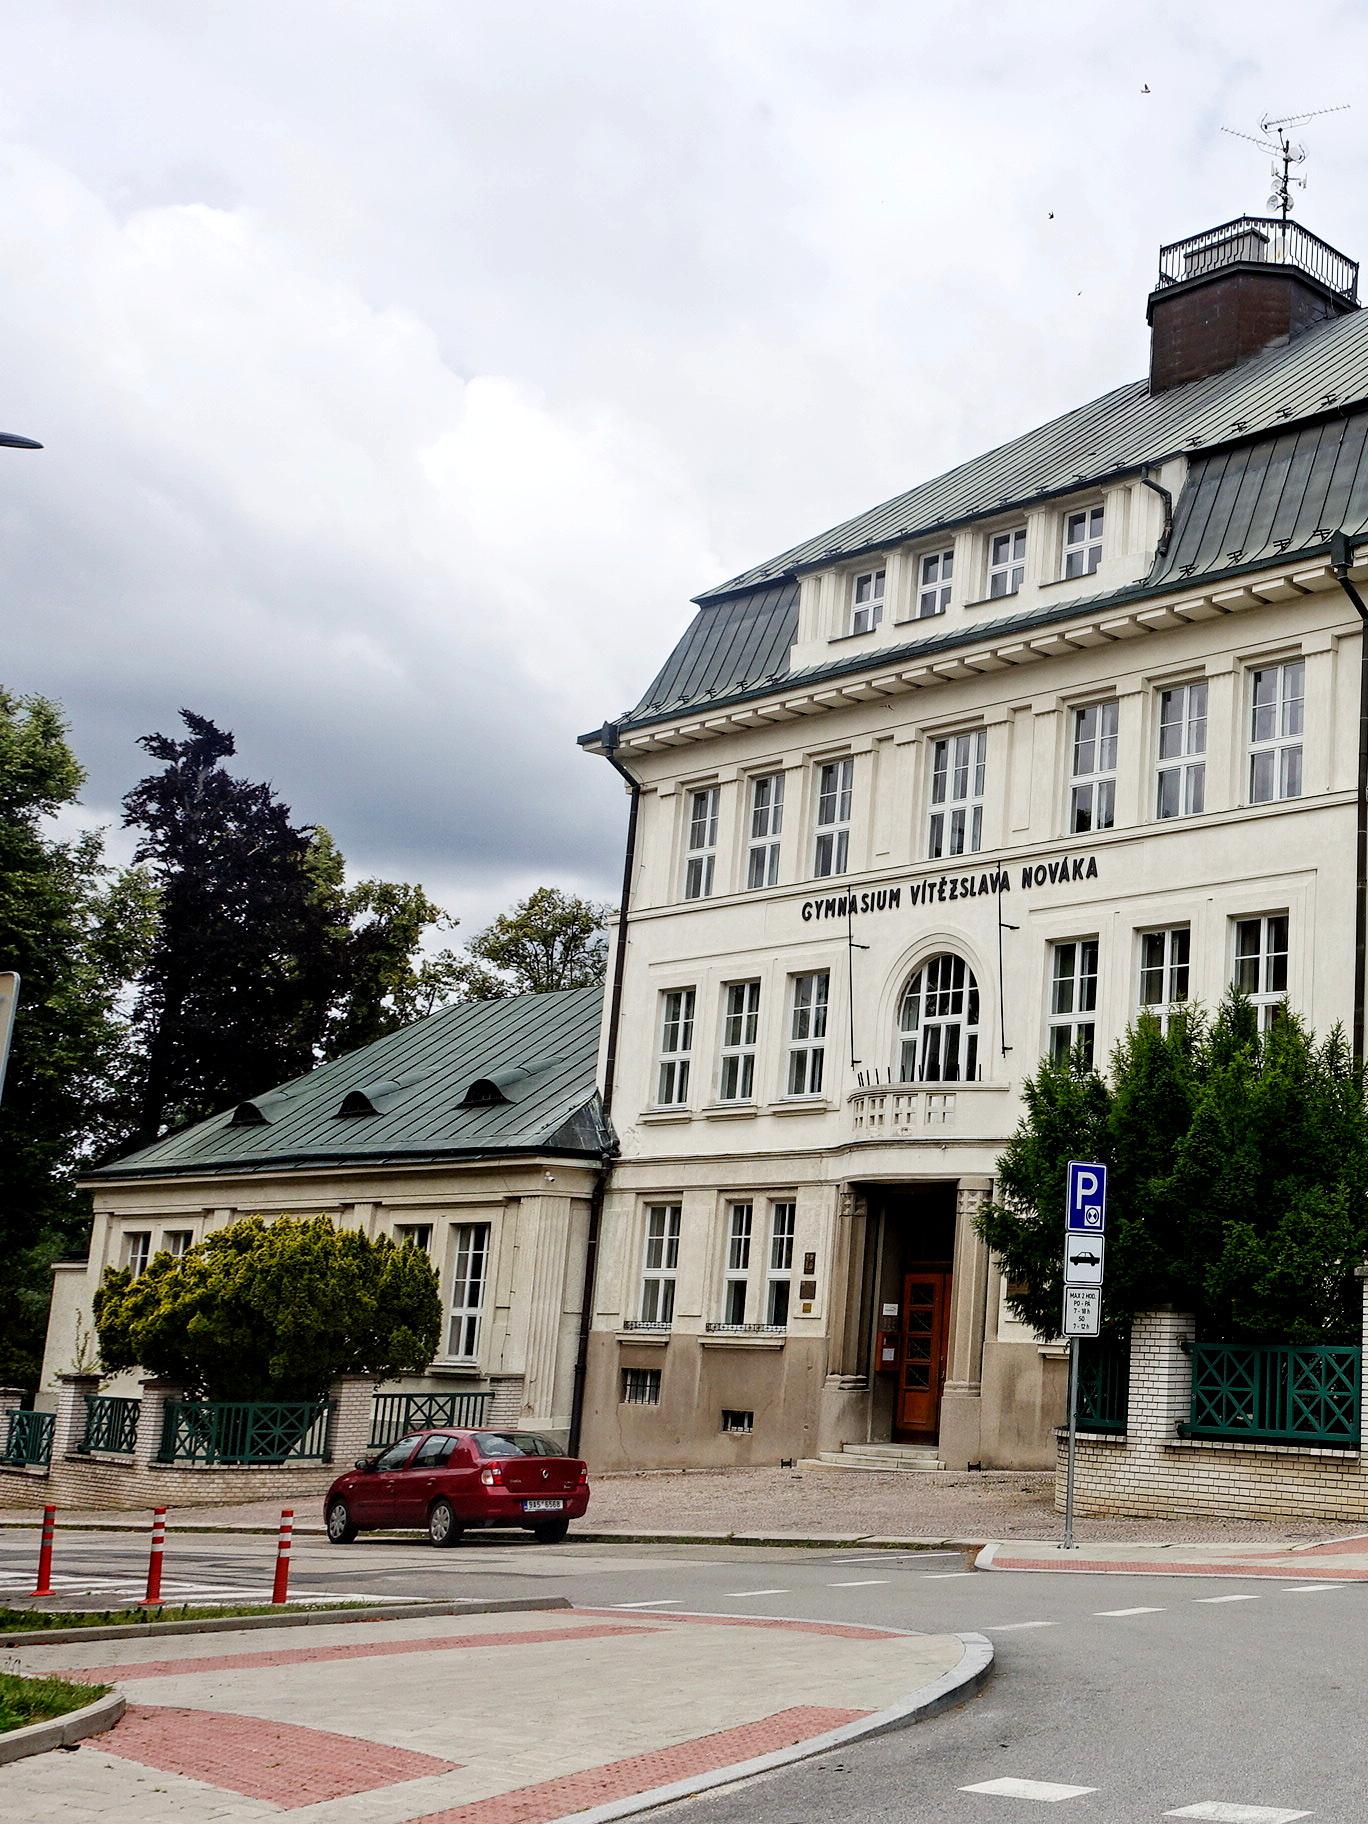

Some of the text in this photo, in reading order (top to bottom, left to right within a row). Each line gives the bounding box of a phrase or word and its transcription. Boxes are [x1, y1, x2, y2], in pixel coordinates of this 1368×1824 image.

[802, 856, 1099, 922] GYMNASIUM VÍTĚZSLAVA NOVÁKA
[1076, 1171, 1099, 1210] P
